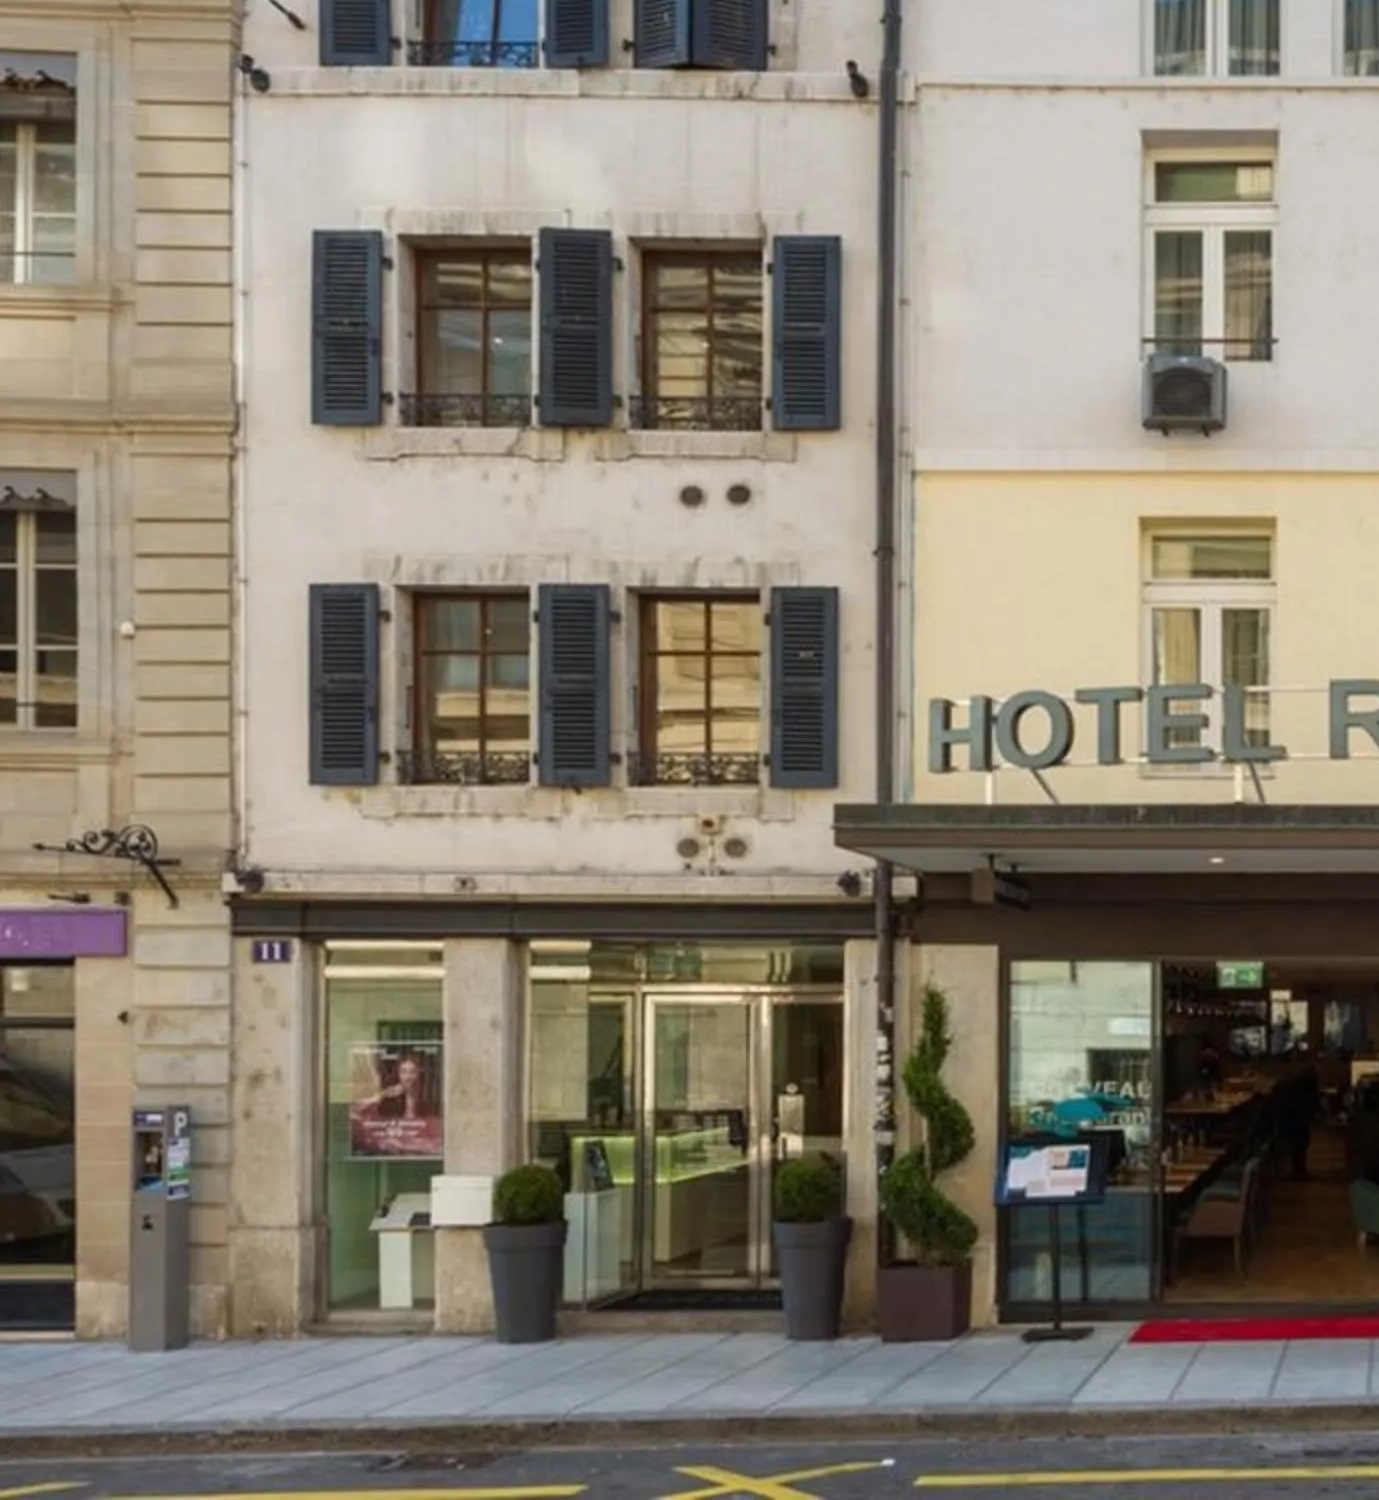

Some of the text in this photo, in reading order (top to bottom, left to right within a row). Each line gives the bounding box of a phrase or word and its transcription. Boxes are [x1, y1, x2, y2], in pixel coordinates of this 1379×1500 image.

[928, 684, 1288, 773] HOTEL
[261, 942, 281, 961] 11
[174, 1111, 188, 1137] P
